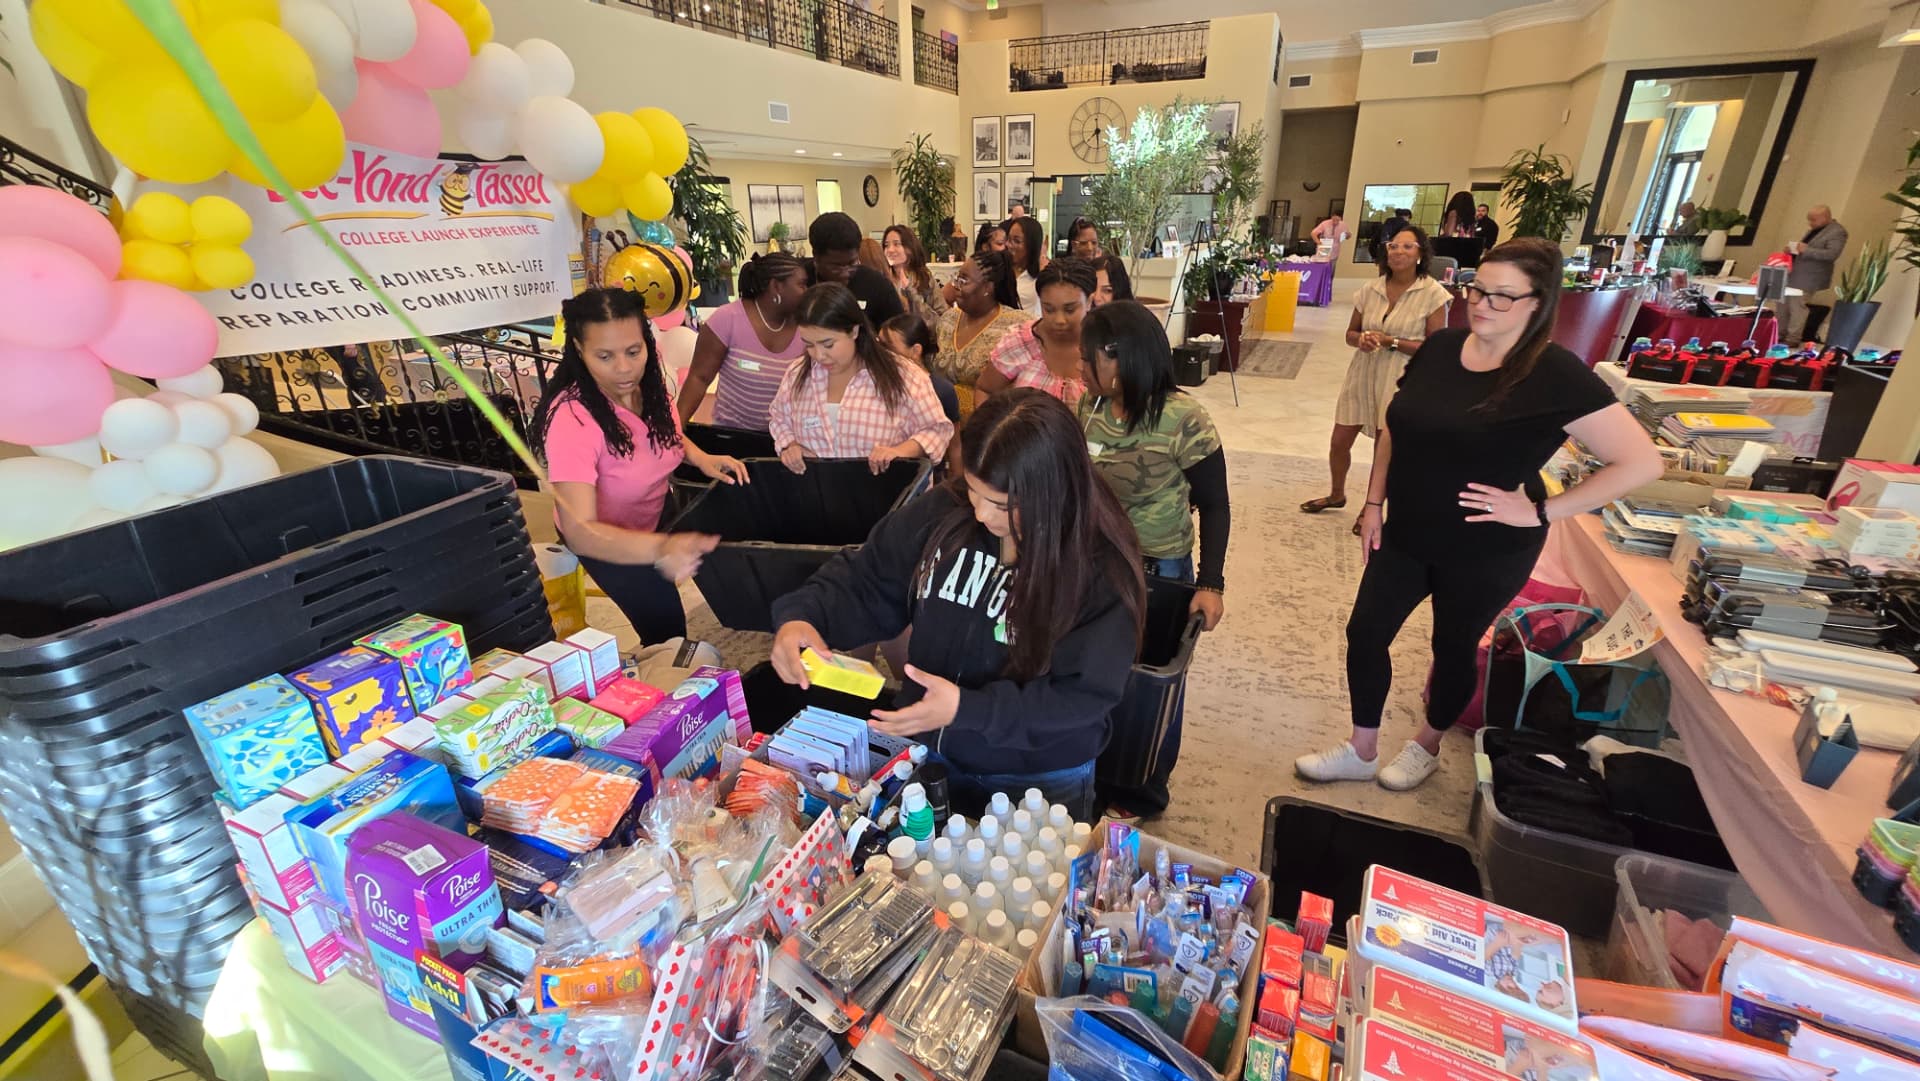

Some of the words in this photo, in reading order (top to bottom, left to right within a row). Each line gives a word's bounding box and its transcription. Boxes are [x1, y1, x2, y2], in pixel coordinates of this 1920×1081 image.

[266, 150, 445, 204] -Yond
[475, 164, 552, 208] Tassel
[340, 230, 409, 246] COLLEGE
[415, 227, 468, 243] LAUNCH
[468, 224, 542, 240] EXPERIENCE
[230, 279, 345, 300] COLLEGE
[349, 265, 474, 292] RADINESS.
[477, 259, 544, 277] REAL-LIFE
[217, 302, 389, 330] REPARATION
[402, 285, 509, 312] COMMUNITY
[514, 281, 559, 297] SUPPORT.
[676, 711, 704, 742] Poise
[354, 873, 410, 931] Poise
[441, 871, 481, 903] Poise
[441, 912, 475, 937] ULTRA
[477, 892, 497, 912] THIN
[1430, 927, 1448, 940] Aid
[1450, 934, 1475, 951] First
[424, 974, 461, 1006] Advil
